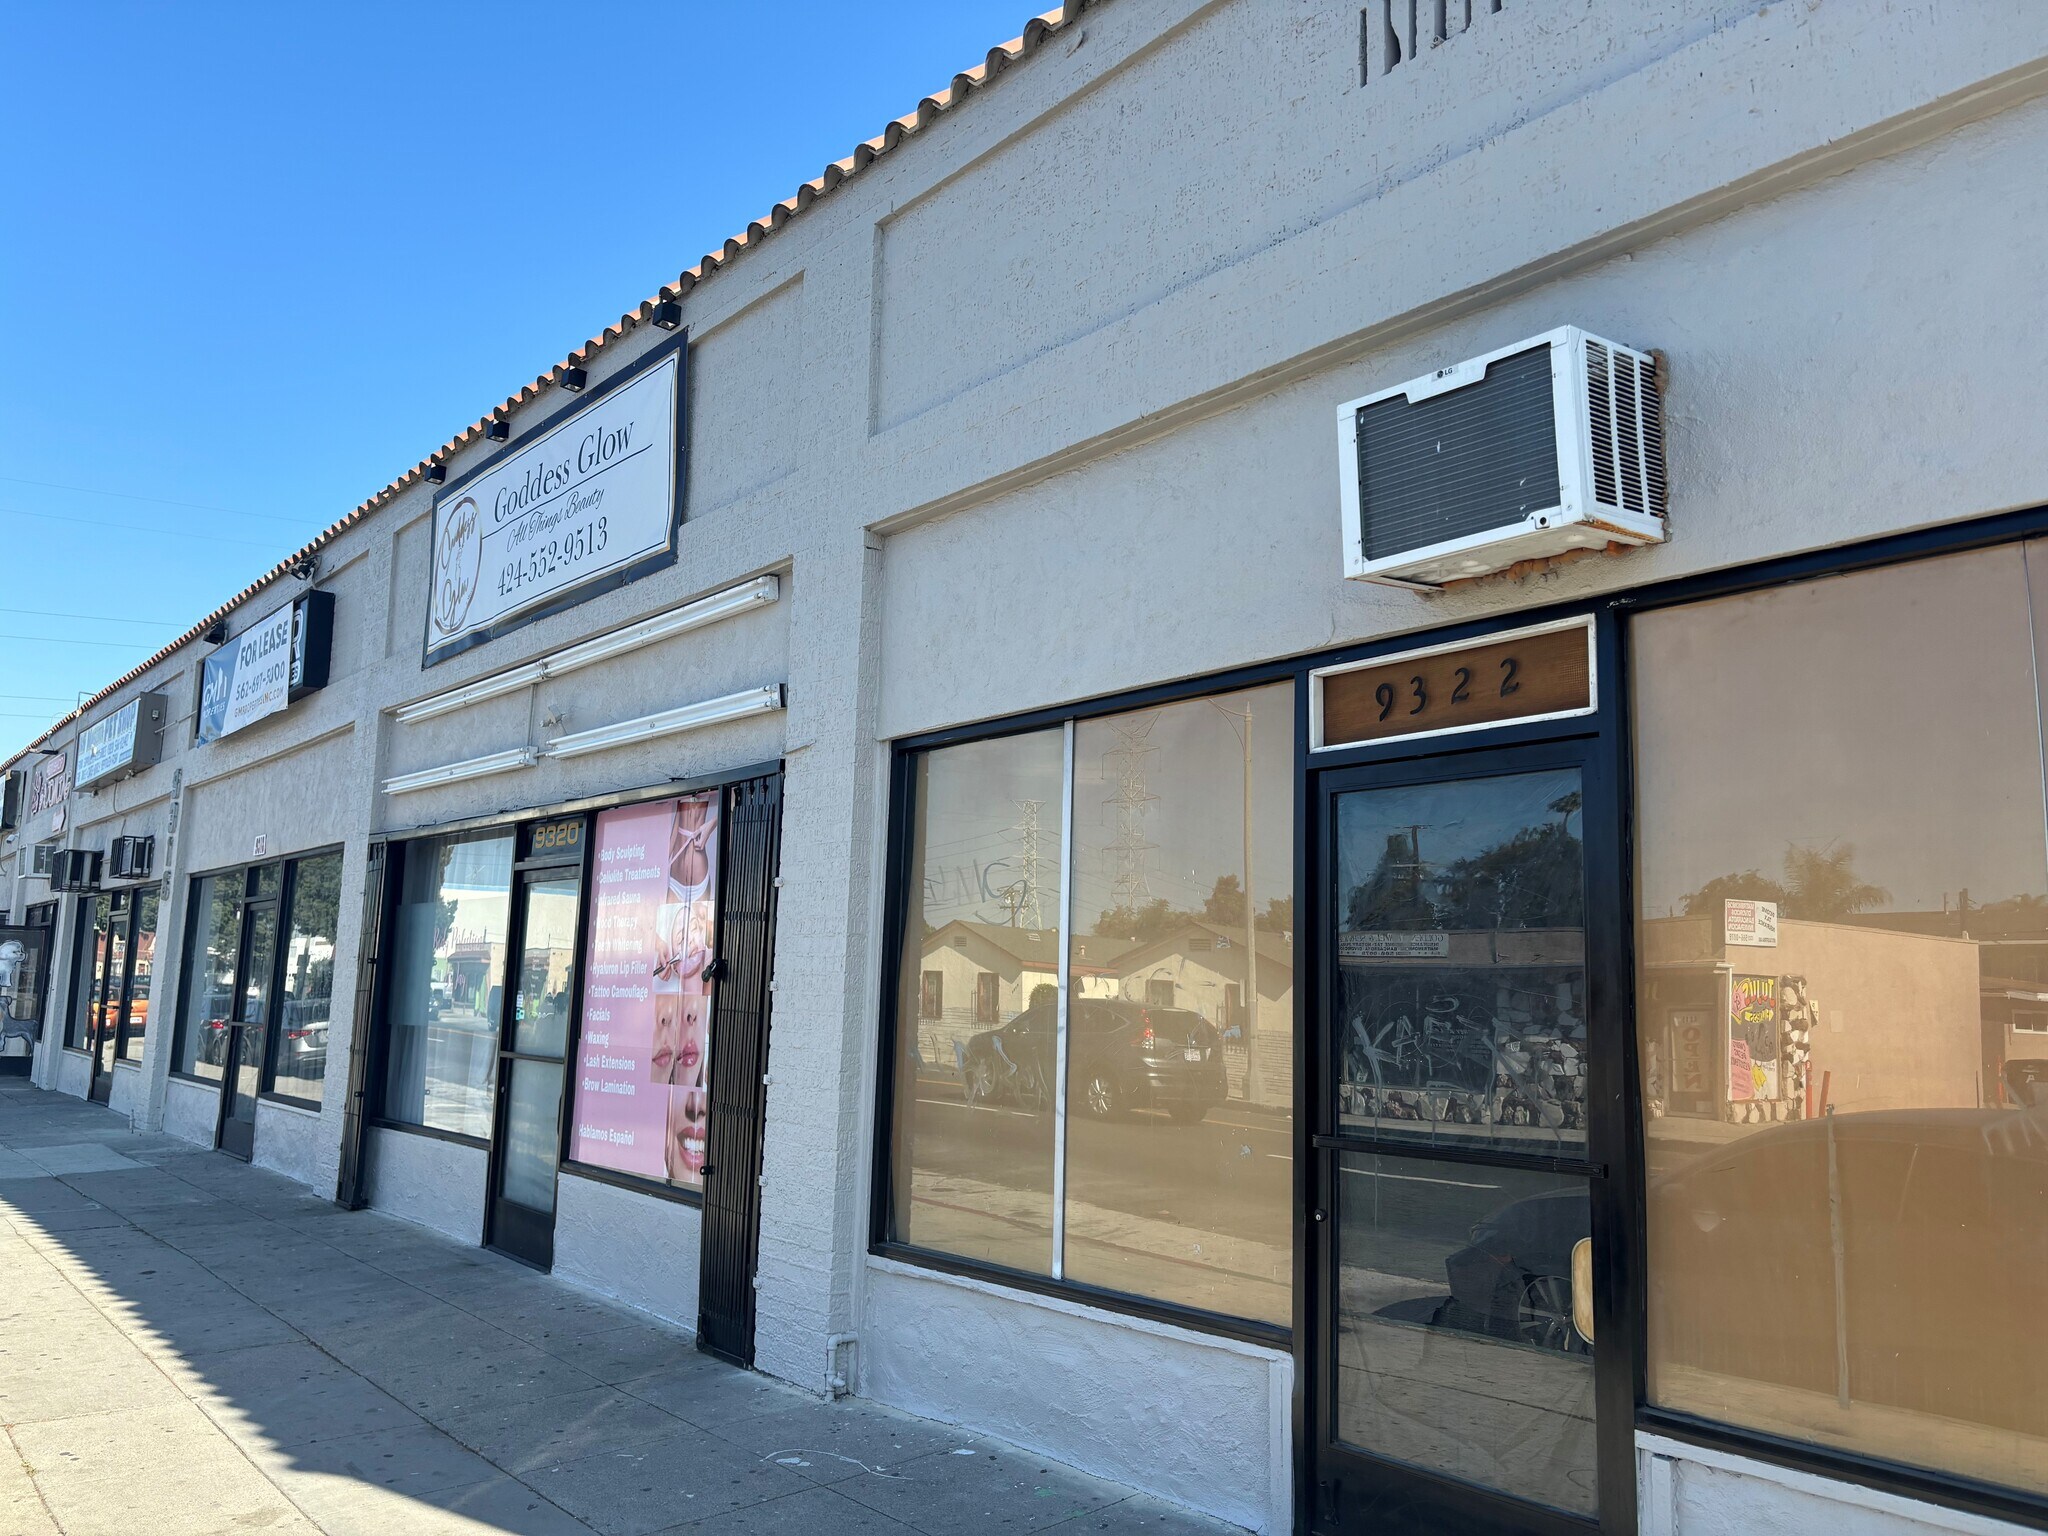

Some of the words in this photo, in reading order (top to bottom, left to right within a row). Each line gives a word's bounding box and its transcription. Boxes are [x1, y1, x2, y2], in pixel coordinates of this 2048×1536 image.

[1444, 366, 1453, 376] LG
[494, 459, 571, 523] Goddess
[577, 421, 635, 476] Glow
[507, 518, 529, 552] All
[528, 509, 563, 541] Things
[563, 487, 605, 518] Beauty
[498, 517, 608, 596] 424-552-9513
[240, 640, 257, 670] FOR
[259, 620, 288, 659] LEASE
[1375, 657, 1519, 722] 9322
[535, 822, 579, 848] 9320
[601, 848, 615, 863] Body
[616, 844, 645, 861] Sculpting
[599, 869, 623, 884] Cellulite
[625, 865, 660, 881] Treatments
[622, 891, 640, 905] Sauna
[614, 915, 637, 930] Therapy
[612, 937, 642, 953] Whitening
[592, 961, 618, 978] Hyaluron
[620, 961, 629, 977] Lip
[631, 960, 647, 975] Filler
[591, 985, 610, 998] Tattoo
[611, 984, 648, 1002] Camouflage
[589, 1007, 610, 1021] Facials
[587, 1031, 609, 1048] Waxing
[586, 1054, 600, 1068] Lash
[601, 1055, 635, 1071] Extensions
[584, 1077, 599, 1091] Brow
[601, 1078, 635, 1095] Lamination
[579, 1124, 608, 1141] Hablamos
[609, 1128, 634, 1146] Español
